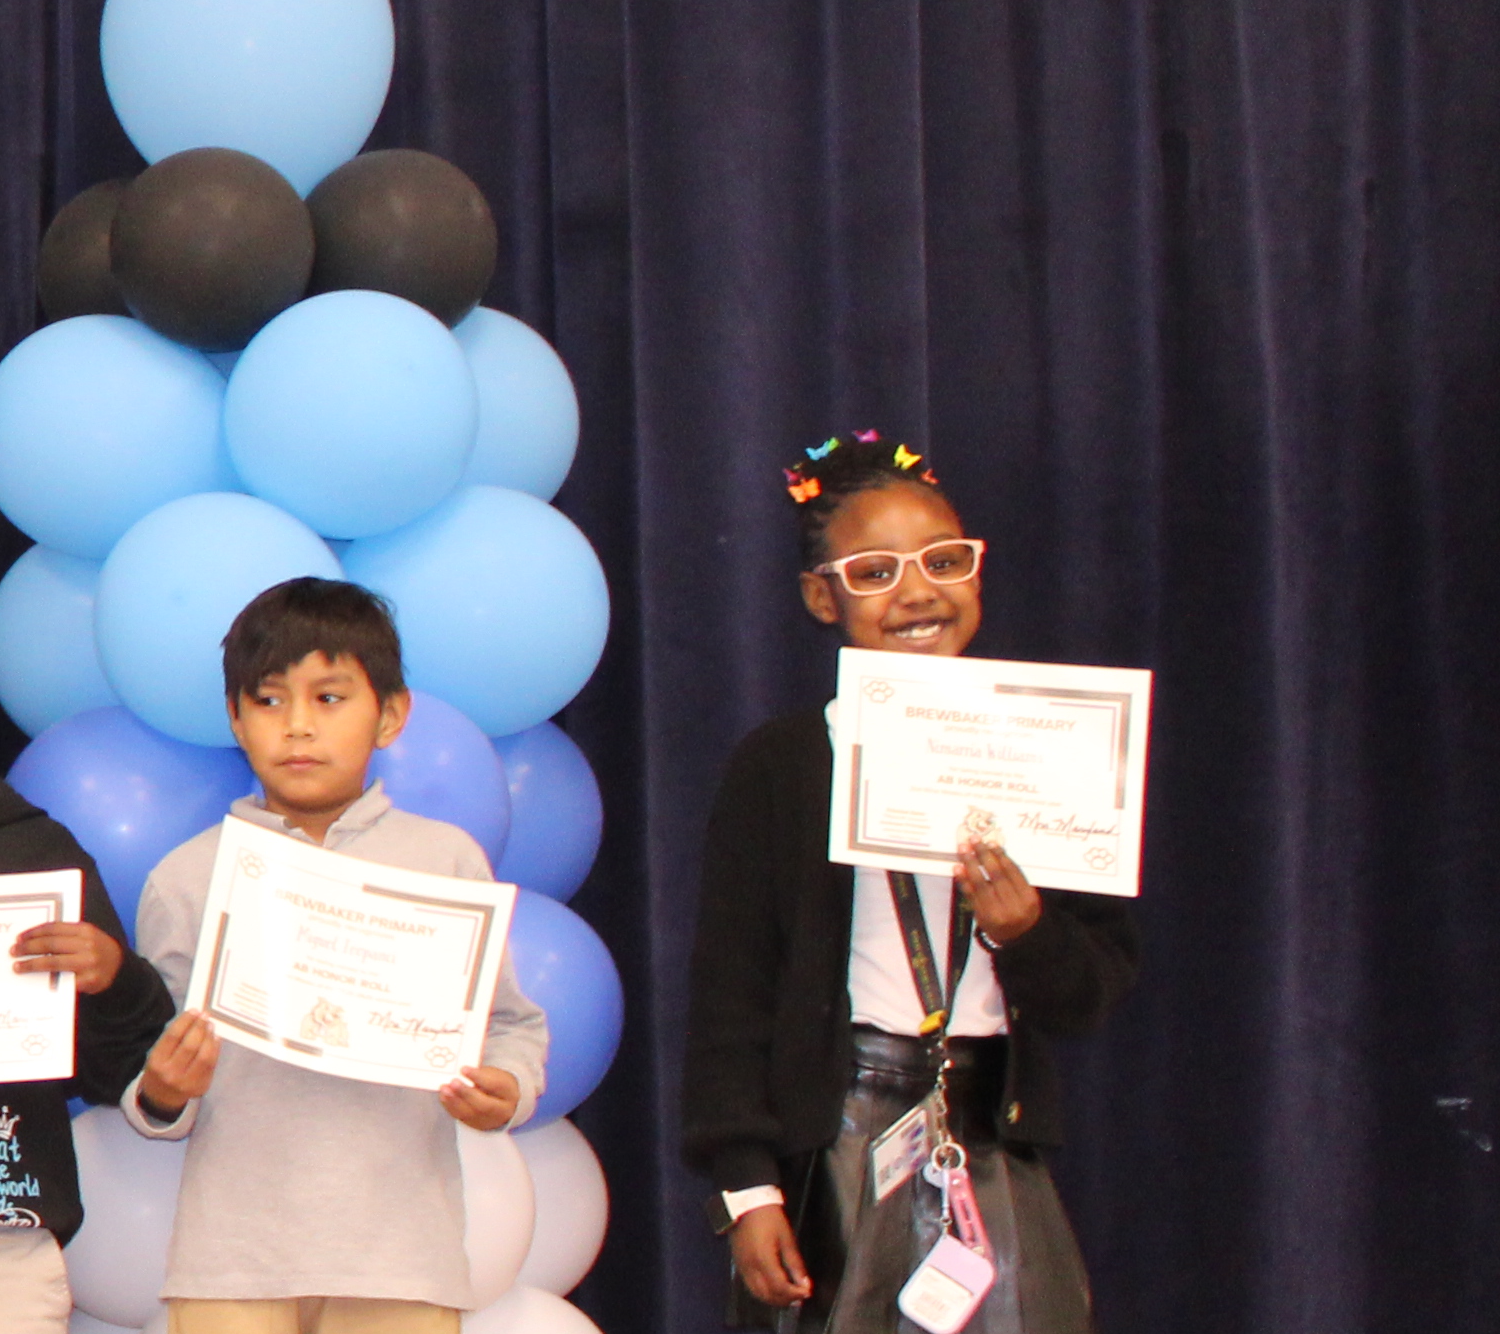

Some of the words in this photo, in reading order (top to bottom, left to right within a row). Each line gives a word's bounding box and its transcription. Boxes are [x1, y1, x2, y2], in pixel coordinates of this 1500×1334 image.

[905, 706, 1000, 724] BREWBAKER
[1007, 715, 1077, 731] PRIMARY
[958, 776, 1003, 789] HONOR
[1007, 781, 1039, 794] ROLL
